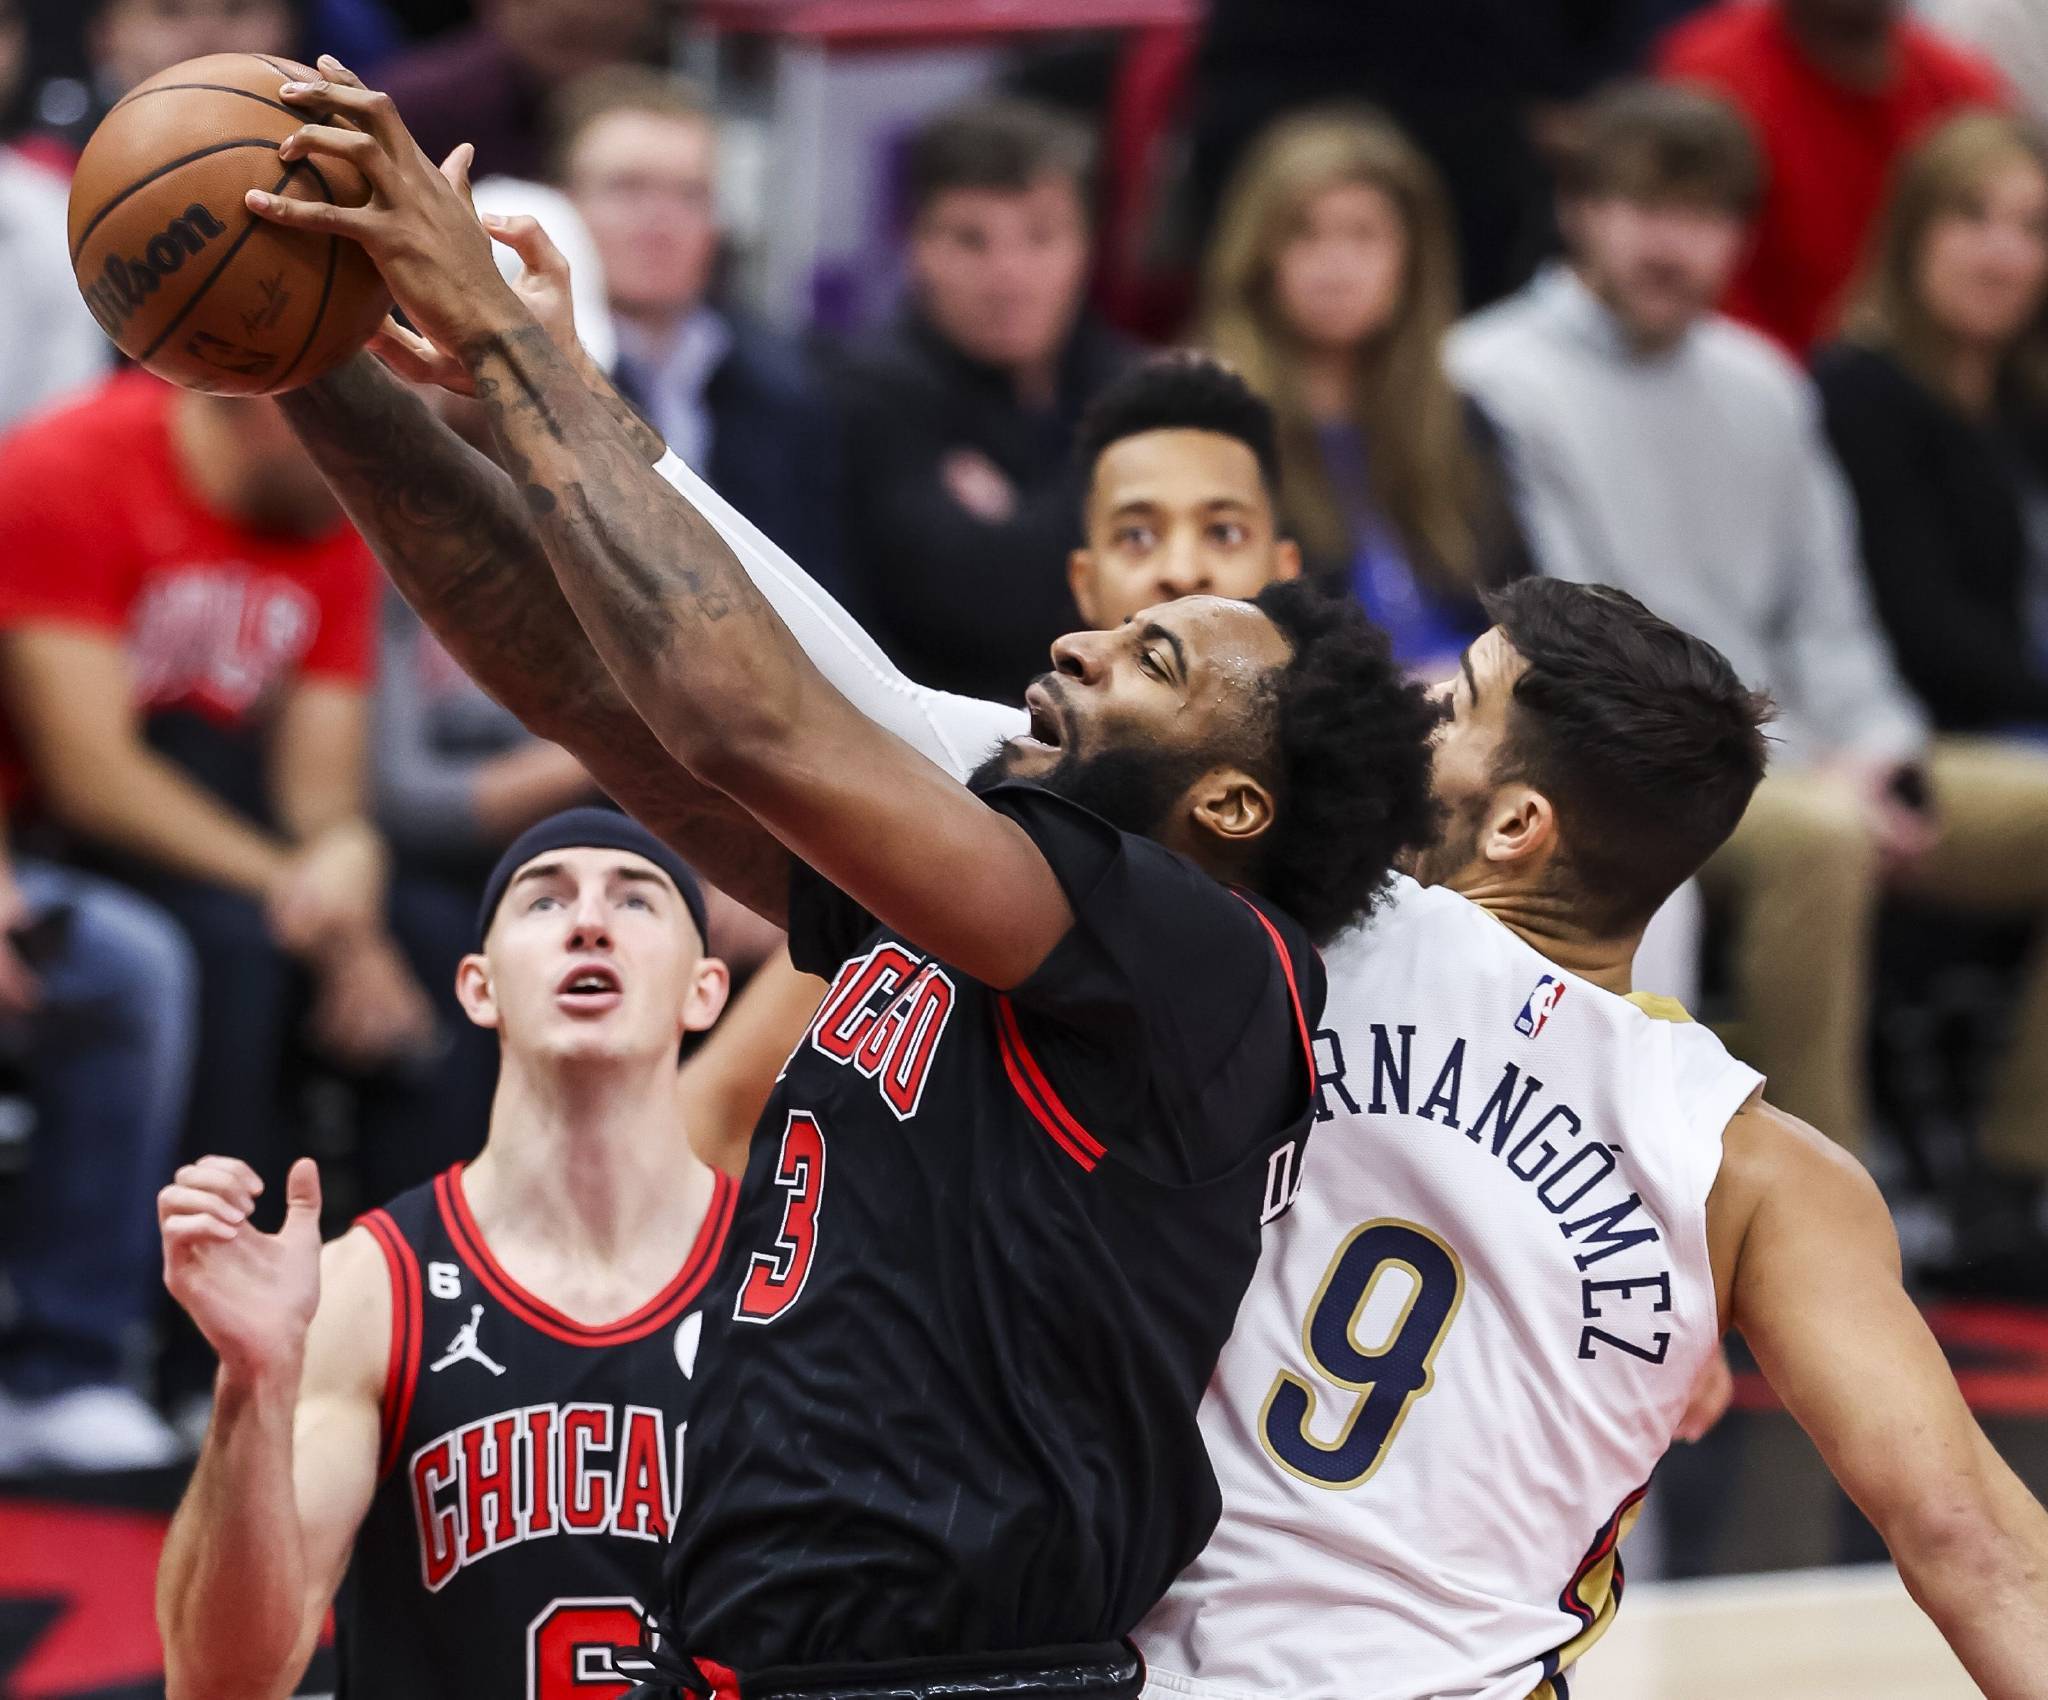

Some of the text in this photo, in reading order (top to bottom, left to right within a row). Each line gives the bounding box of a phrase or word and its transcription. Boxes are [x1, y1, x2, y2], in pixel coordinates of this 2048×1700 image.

[428, 1261, 462, 1299] 6
[732, 1108, 826, 1325] 3
[1257, 1217, 1466, 1492] 9
[408, 1401, 688, 1594] CHICA
